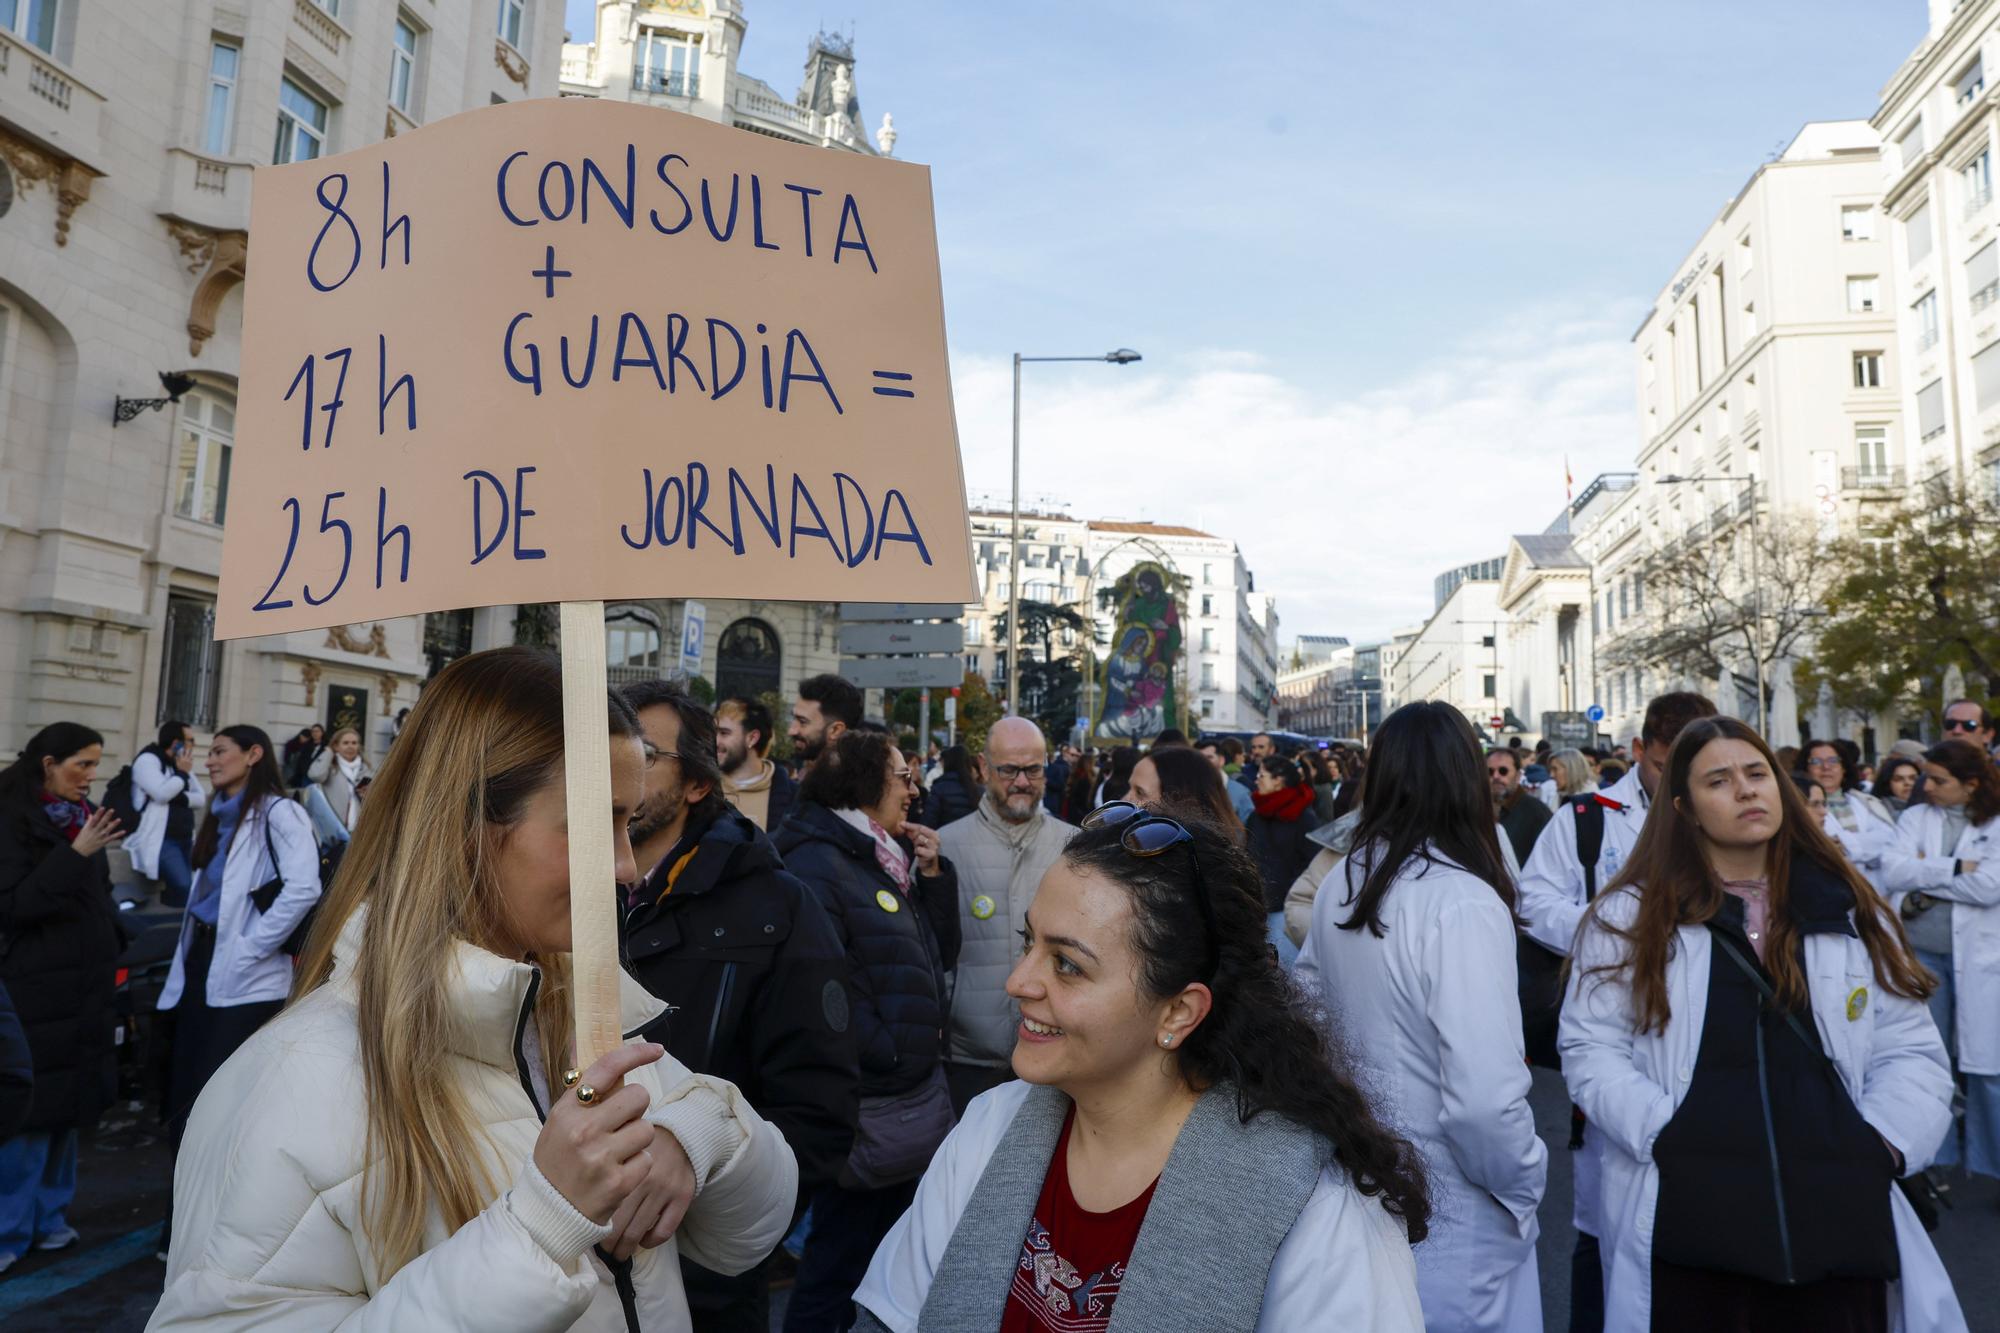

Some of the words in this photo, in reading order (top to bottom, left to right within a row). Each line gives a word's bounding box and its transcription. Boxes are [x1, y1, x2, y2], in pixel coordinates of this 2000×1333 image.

[497, 144, 878, 273] CONSULTA
[463, 466, 546, 566] DE
[620, 462, 932, 568] JORNADA
